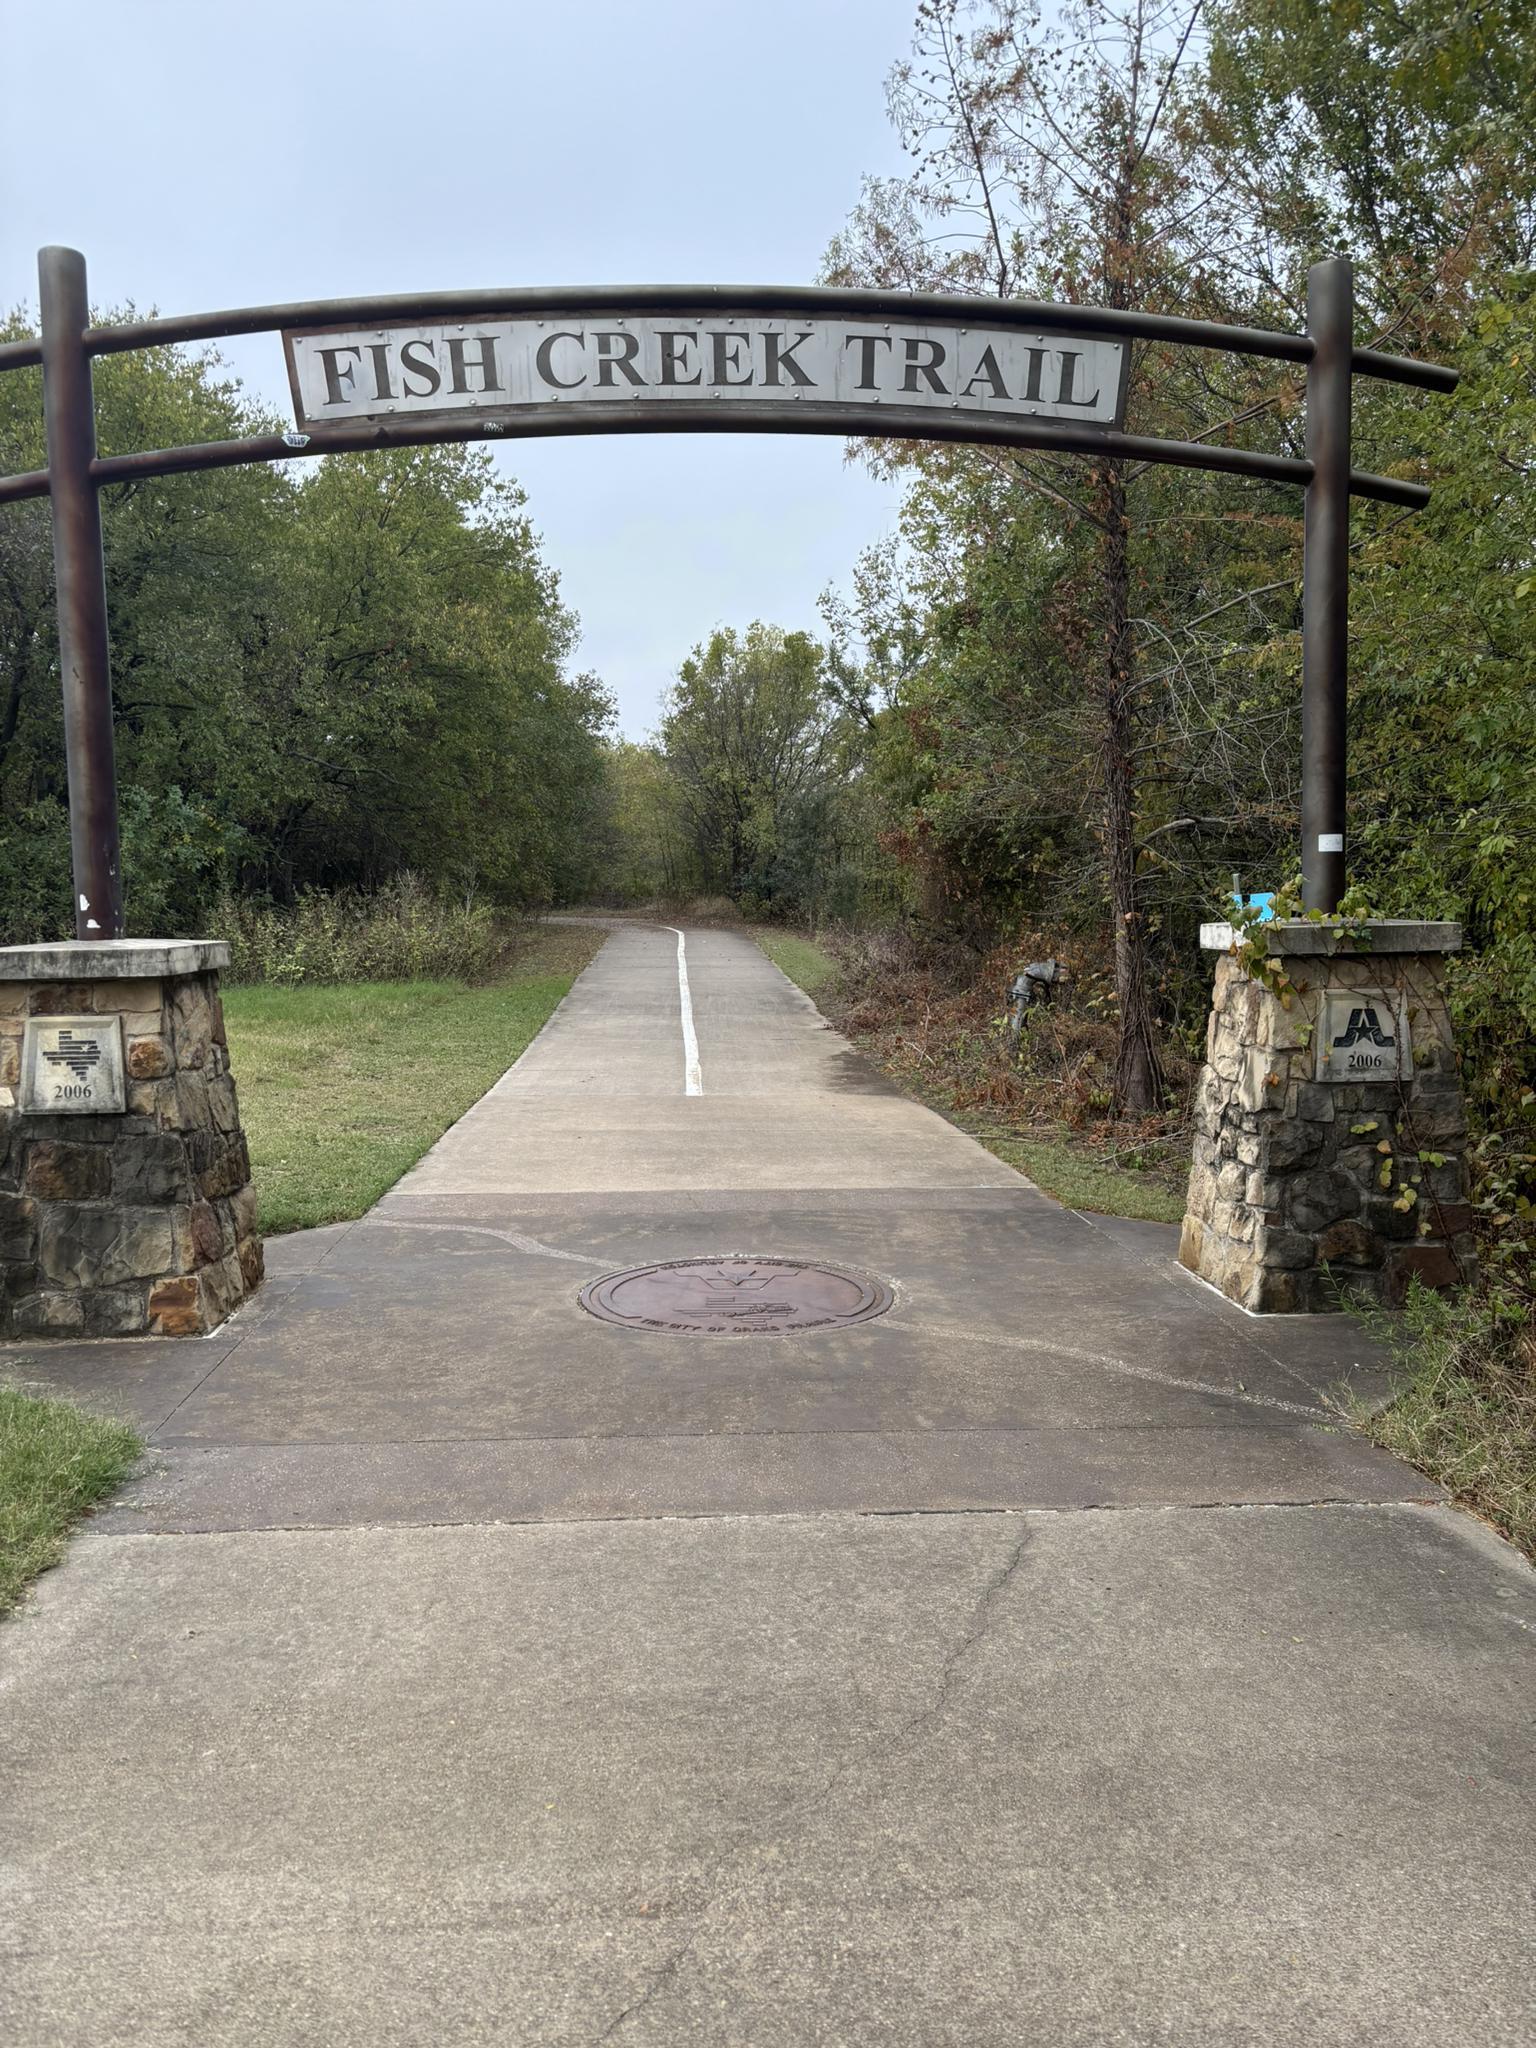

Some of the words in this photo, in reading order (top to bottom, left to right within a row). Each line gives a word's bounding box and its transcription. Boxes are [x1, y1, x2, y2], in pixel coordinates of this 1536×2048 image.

[314, 335, 506, 406] FISH
[536, 330, 818, 390] CREEK
[845, 334, 1101, 408] TRAIL
[1348, 1054, 1382, 1068] 2006
[54, 1084, 92, 1099] 2006
